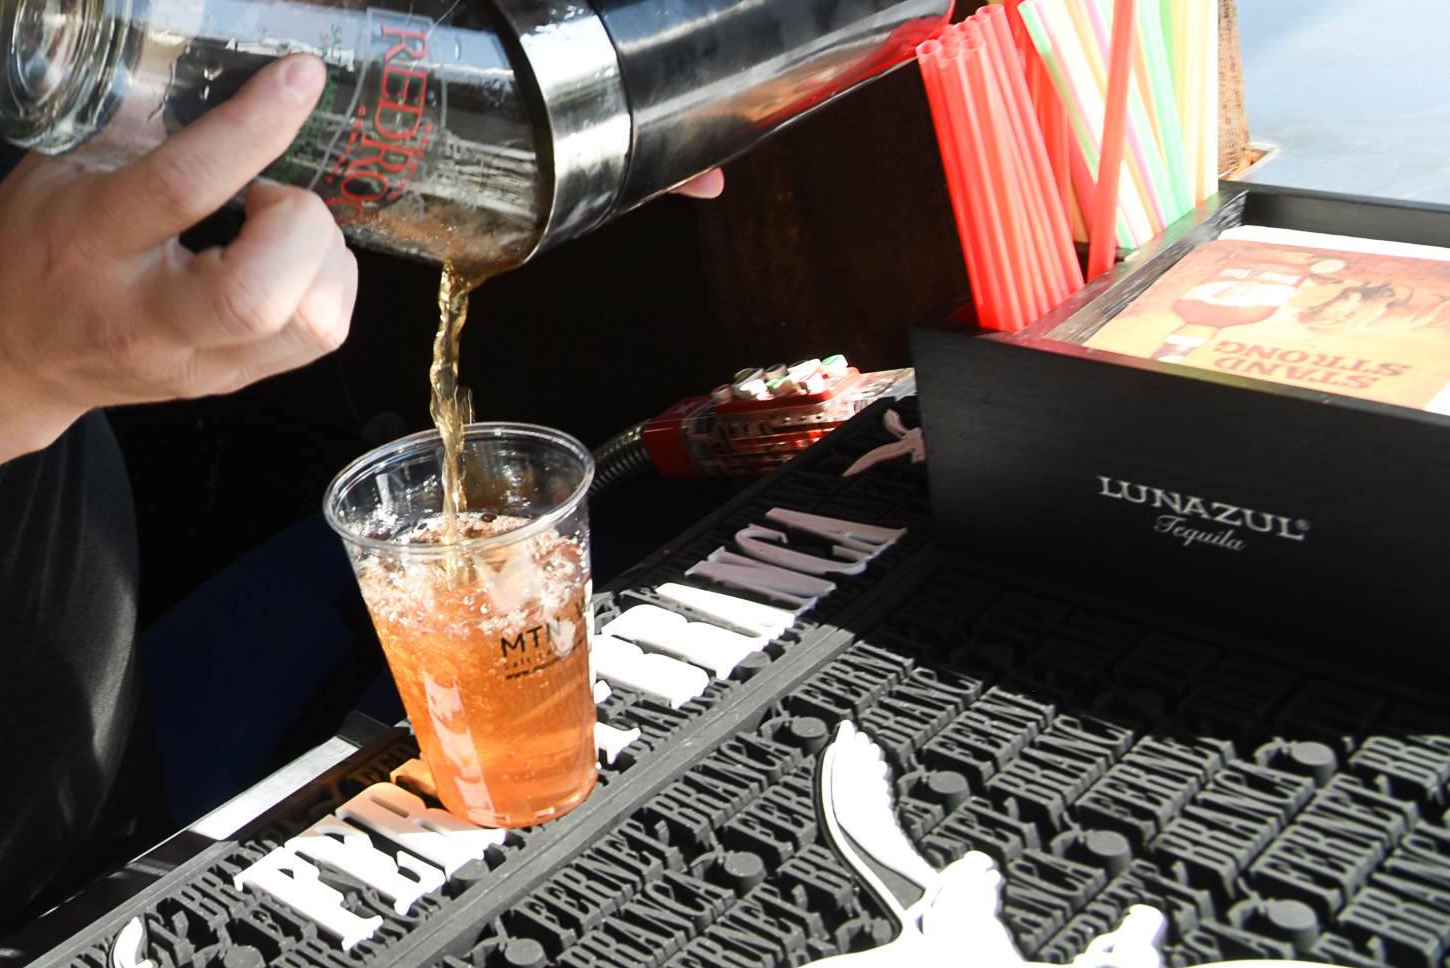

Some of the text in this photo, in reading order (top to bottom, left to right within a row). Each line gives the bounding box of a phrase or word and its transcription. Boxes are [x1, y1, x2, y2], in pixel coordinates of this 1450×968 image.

[1213, 341, 1411, 376] STRONG
[1213, 356, 1381, 389] STAND
[1153, 514, 1247, 552] Tequila
[501, 617, 561, 657] MTN
